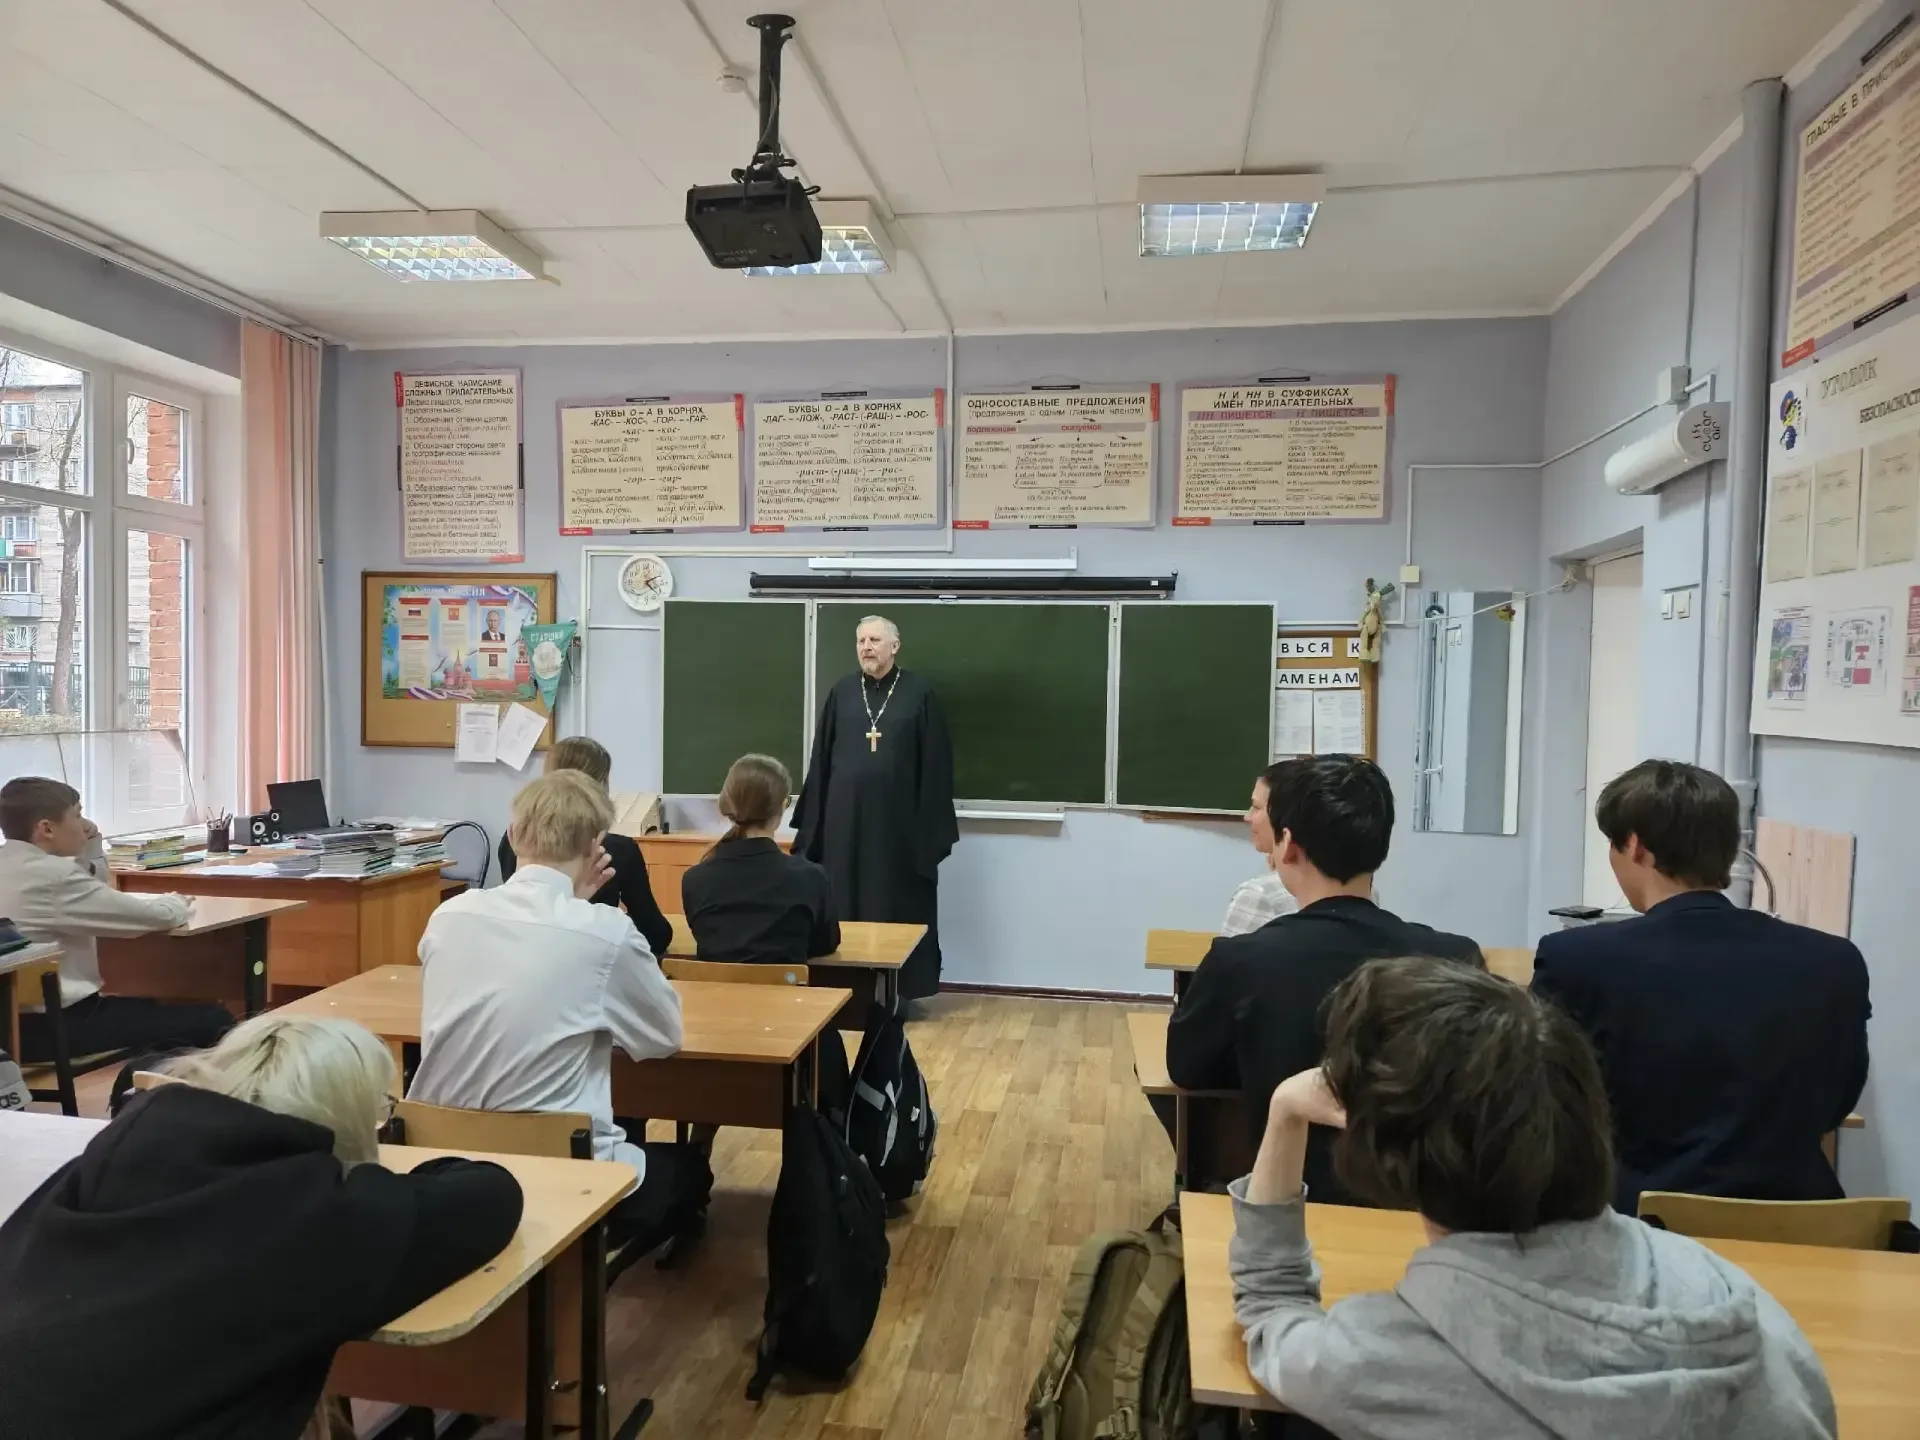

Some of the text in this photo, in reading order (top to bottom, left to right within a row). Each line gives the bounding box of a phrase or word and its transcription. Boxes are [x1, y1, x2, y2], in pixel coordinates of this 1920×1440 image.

[405, 388, 442, 396] СЛОЖНЫХ
[445, 388, 514, 396] ПРИЛАГАТЕЛЬНЫХ
[1246, 390, 1262, 398] НН
[1282, 388, 1349, 397] СУФФИКСАХ
[865, 403, 901, 411] КОРНЯХ
[967, 397, 1145, 408] ОДНОСОСТАВНЫЕ ПРЕДЛОЖЕНИЯ
[1250, 397, 1353, 408] ПРИЛАГАТЕЛЬНЫХ
[595, 410, 625, 418] БУКВЫ
[1221, 411, 1276, 420] ПИШЕТСЯ:
[1311, 408, 1368, 417] ПИШЕТСЯ:
[1712, 421, 1720, 440] air
